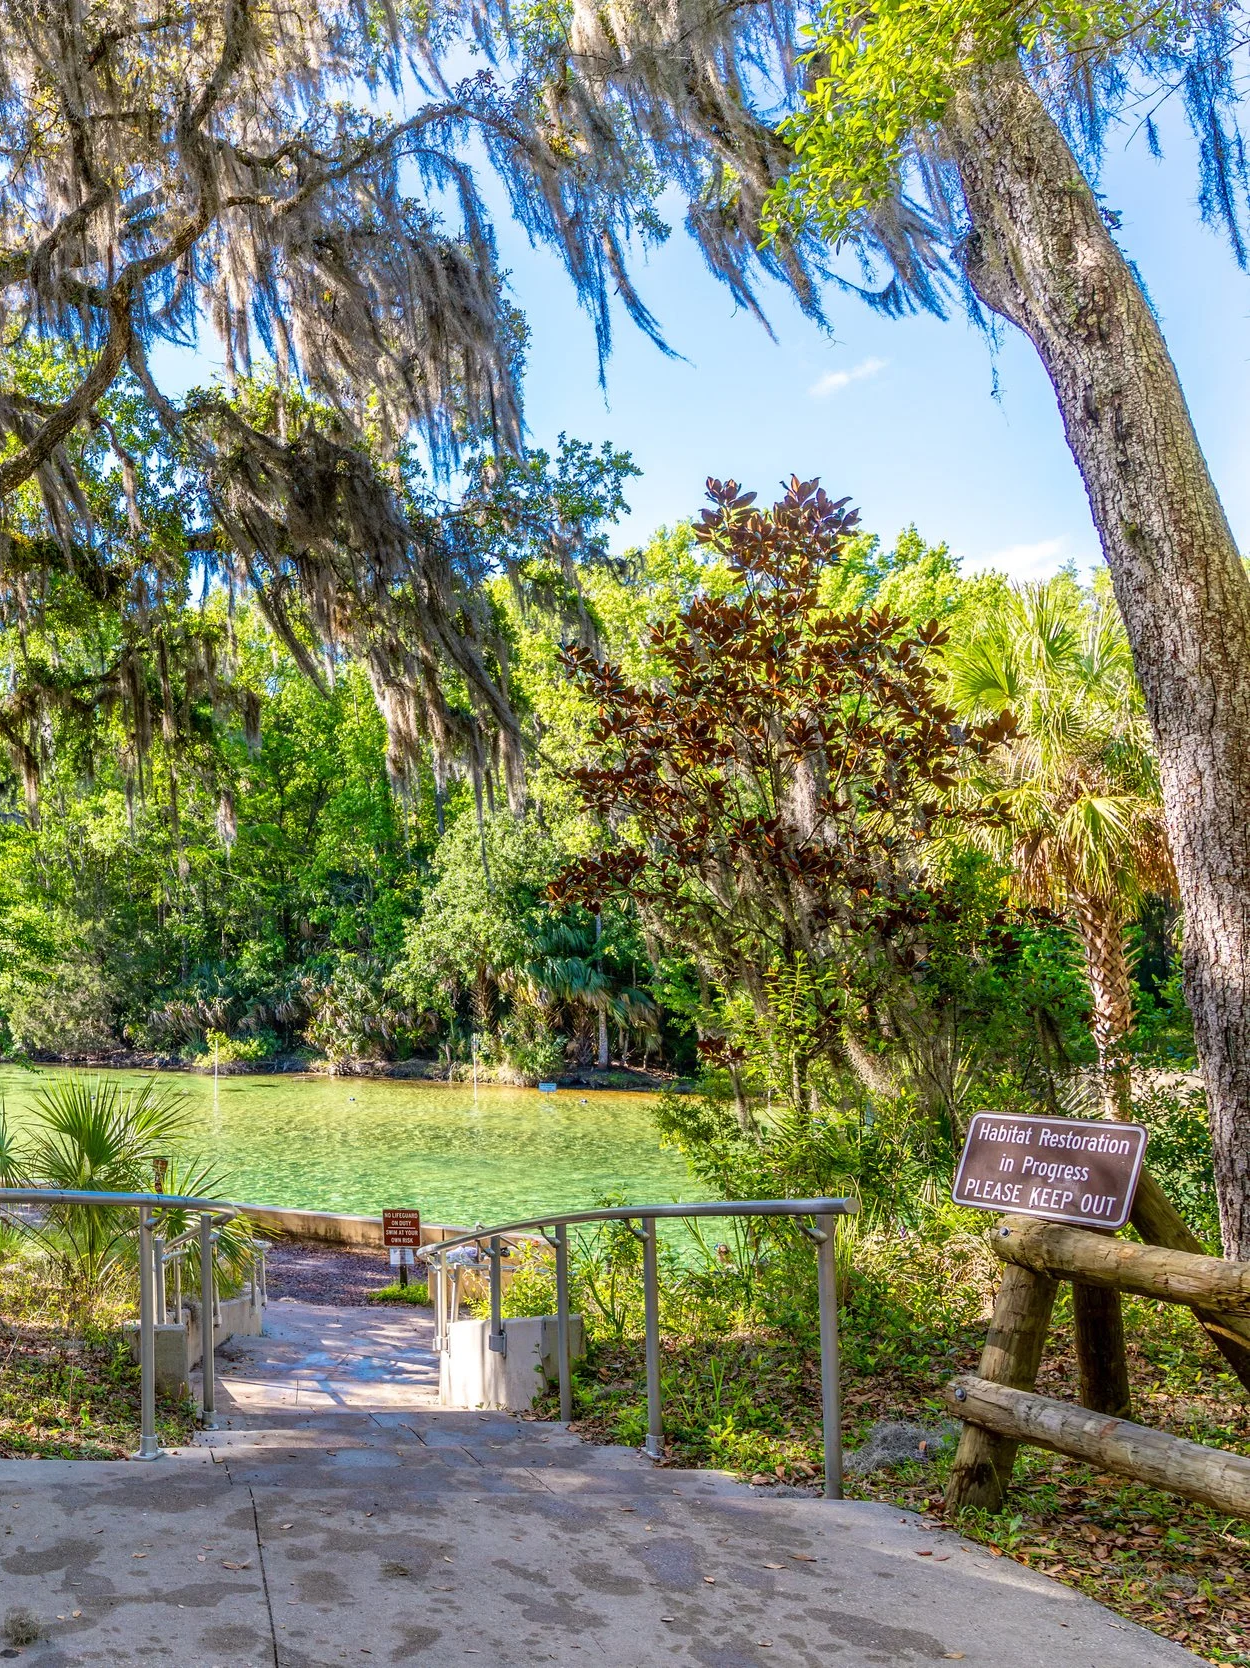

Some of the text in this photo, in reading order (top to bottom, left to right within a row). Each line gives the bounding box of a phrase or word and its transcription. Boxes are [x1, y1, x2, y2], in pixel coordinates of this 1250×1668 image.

[978, 1122, 1130, 1155] Habitat Restoration
[999, 1153, 1090, 1183] in Progress
[964, 1178, 1117, 1217] PLEASE KEEP OUT
